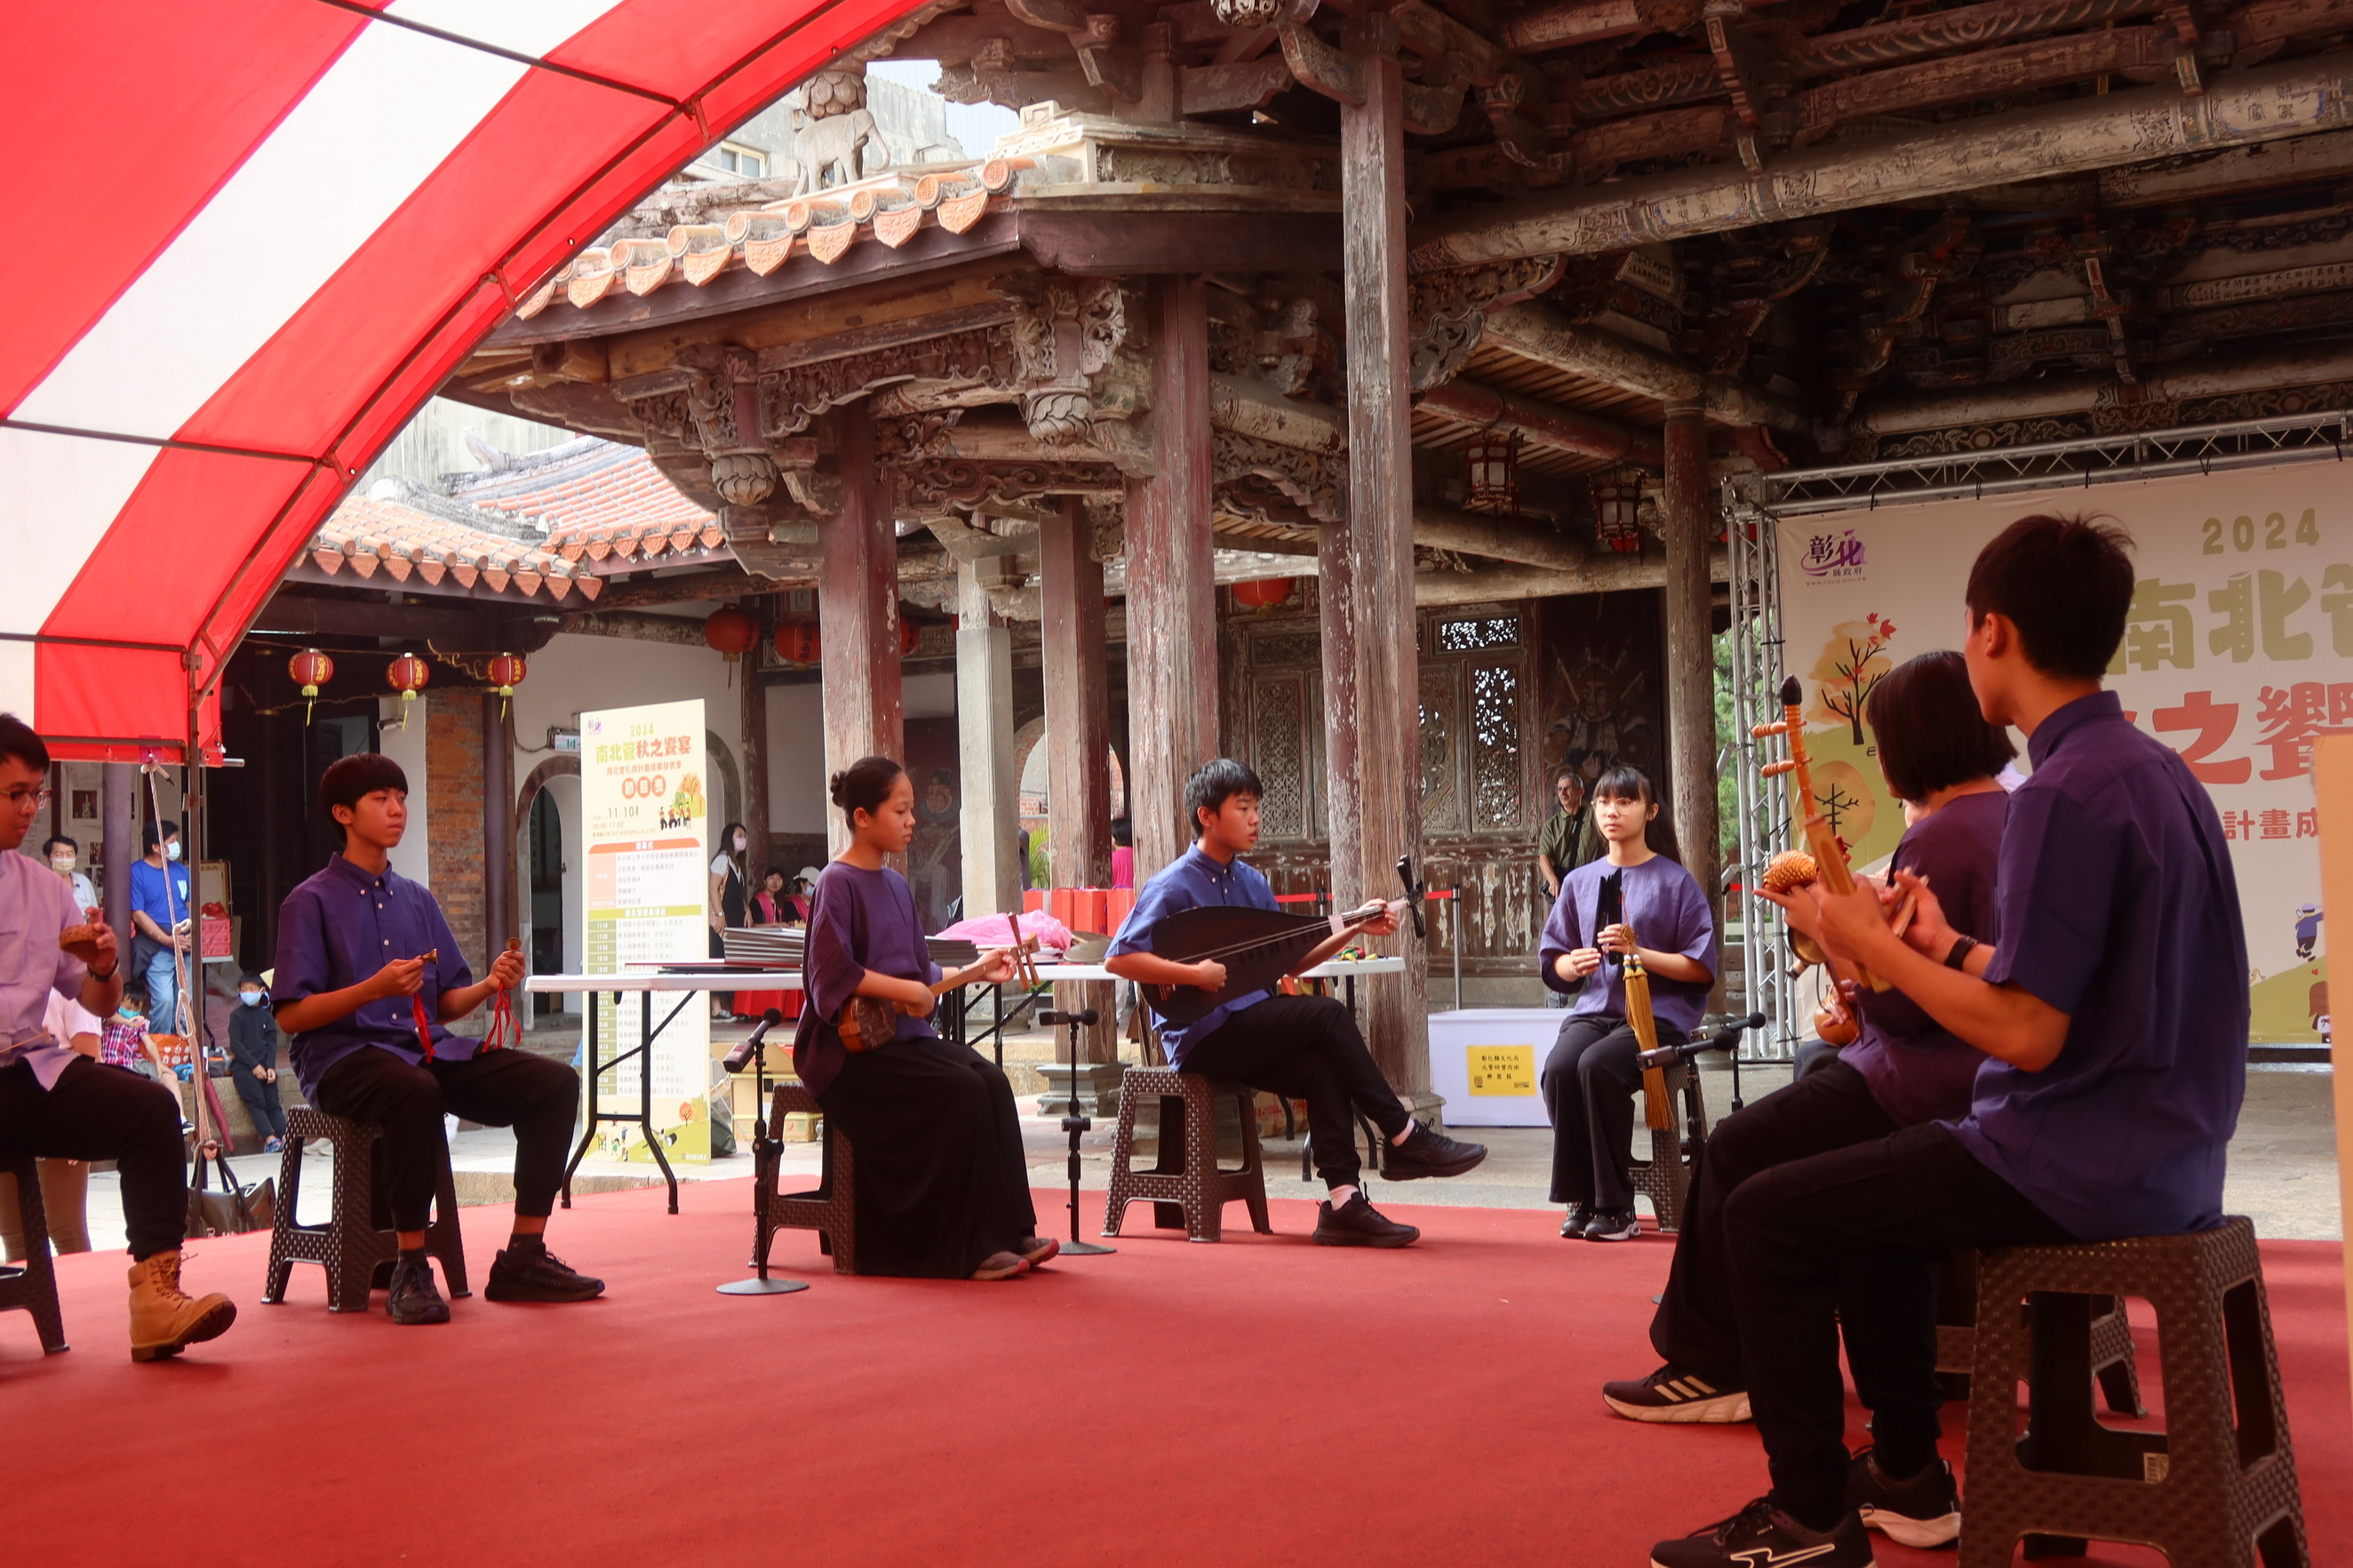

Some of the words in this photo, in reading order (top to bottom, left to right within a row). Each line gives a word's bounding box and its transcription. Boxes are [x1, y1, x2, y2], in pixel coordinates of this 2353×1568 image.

[1809, 529, 1862, 567] 彰化
[2202, 508, 2319, 555] 2024
[1832, 567, 1862, 577] 縣政府
[630, 723, 654, 737] 2024
[2127, 681, 2353, 784] 之饗
[624, 776, 665, 797] 節目表
[2222, 807, 2319, 840] 計畫成
